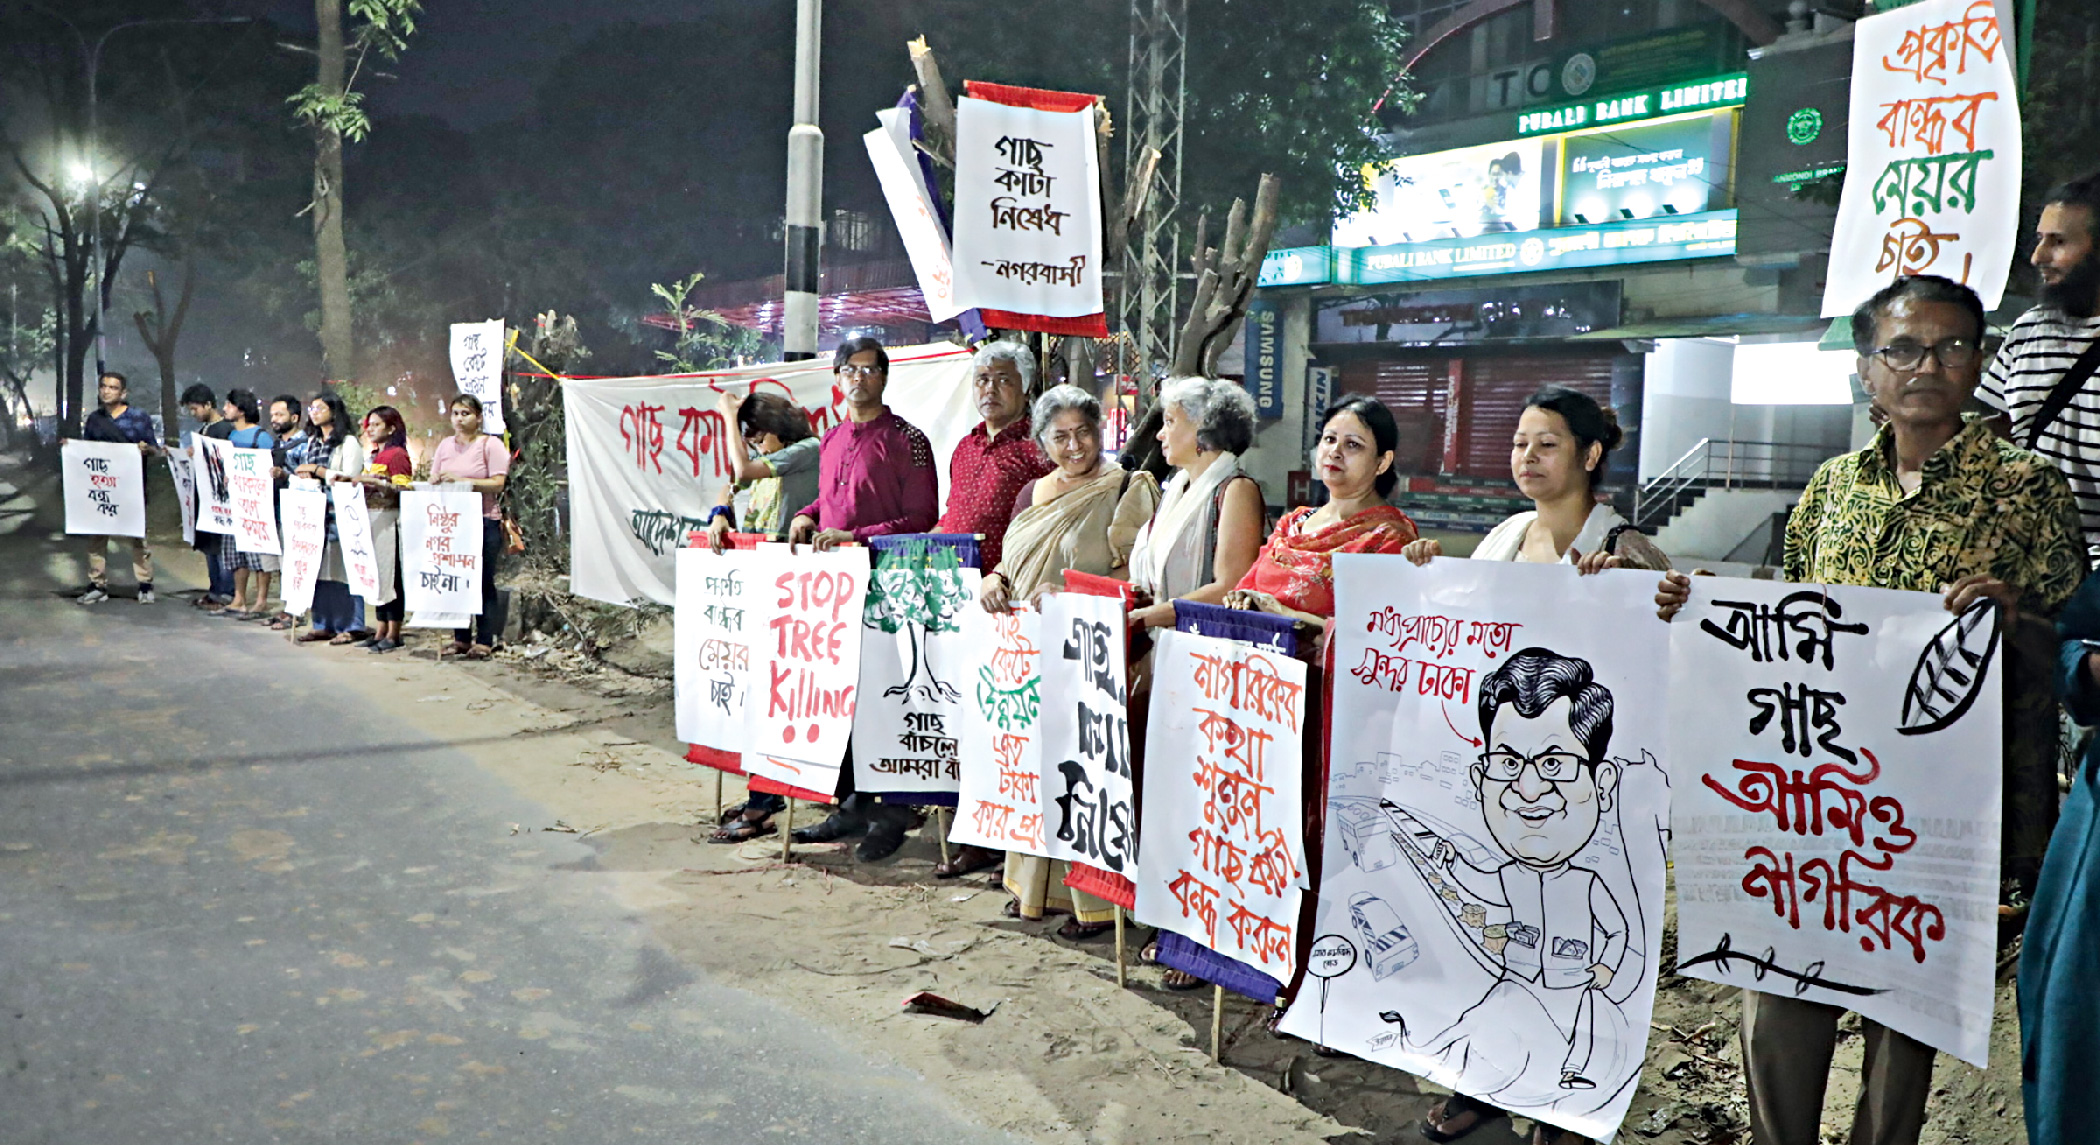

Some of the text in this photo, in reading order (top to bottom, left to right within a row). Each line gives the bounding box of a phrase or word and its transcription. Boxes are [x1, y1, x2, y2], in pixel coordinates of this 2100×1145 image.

[1519, 105, 1588, 134] PUBALI
[1596, 94, 1649, 121] BANK
[1877, 91, 1999, 155] বান্ধব
[995, 135, 1054, 174] গাছ
[994, 168, 1057, 197] কাটা
[1872, 148, 1994, 218] মেয়র
[991, 197, 1071, 236] নিষেধ
[1367, 250, 1414, 271] PUBALI
[1416, 248, 1452, 267] BANK
[1454, 243, 1516, 262] LIMITED
[1259, 309, 1275, 409] SAMSUNG
[233, 452, 257, 476] গাছ
[620, 400, 665, 476] গাছ
[83, 456, 111, 475] গাছ
[88, 489, 111, 504] বন্ধ
[97, 503, 119, 517] কর
[427, 503, 461, 534] নিষ্ঠুর
[425, 534, 455, 552] নগর
[428, 552, 476, 570] প্রশাসন
[775, 570, 855, 622] STOP
[699, 638, 749, 671] মেয়র
[769, 613, 847, 666] TREE
[1366, 605, 1524, 660] মধ্যপ্রাচ্যের মতো
[1700, 590, 1869, 671] আমি
[991, 634, 1041, 684] কেটে
[1063, 617, 1117, 701] গাছ
[1350, 647, 1477, 705] সুন্দর ঢাকা
[1188, 652, 1302, 735] নাগরিকের
[897, 730, 959, 759] বাঁচলে
[903, 711, 947, 736] গাছ
[1191, 708, 1274, 783] কথা
[1748, 682, 1858, 765] গাছ
[869, 757, 942, 781] আমরা
[972, 799, 1015, 840] কার
[1055, 760, 1138, 872] নিষে
[1192, 754, 1275, 842] শুনুন
[1702, 747, 1917, 854] আমিও
[1188, 826, 1249, 899] গাছ
[1168, 868, 1293, 977] বন্ধ করুন
[1742, 845, 1946, 963] নাগরিক
